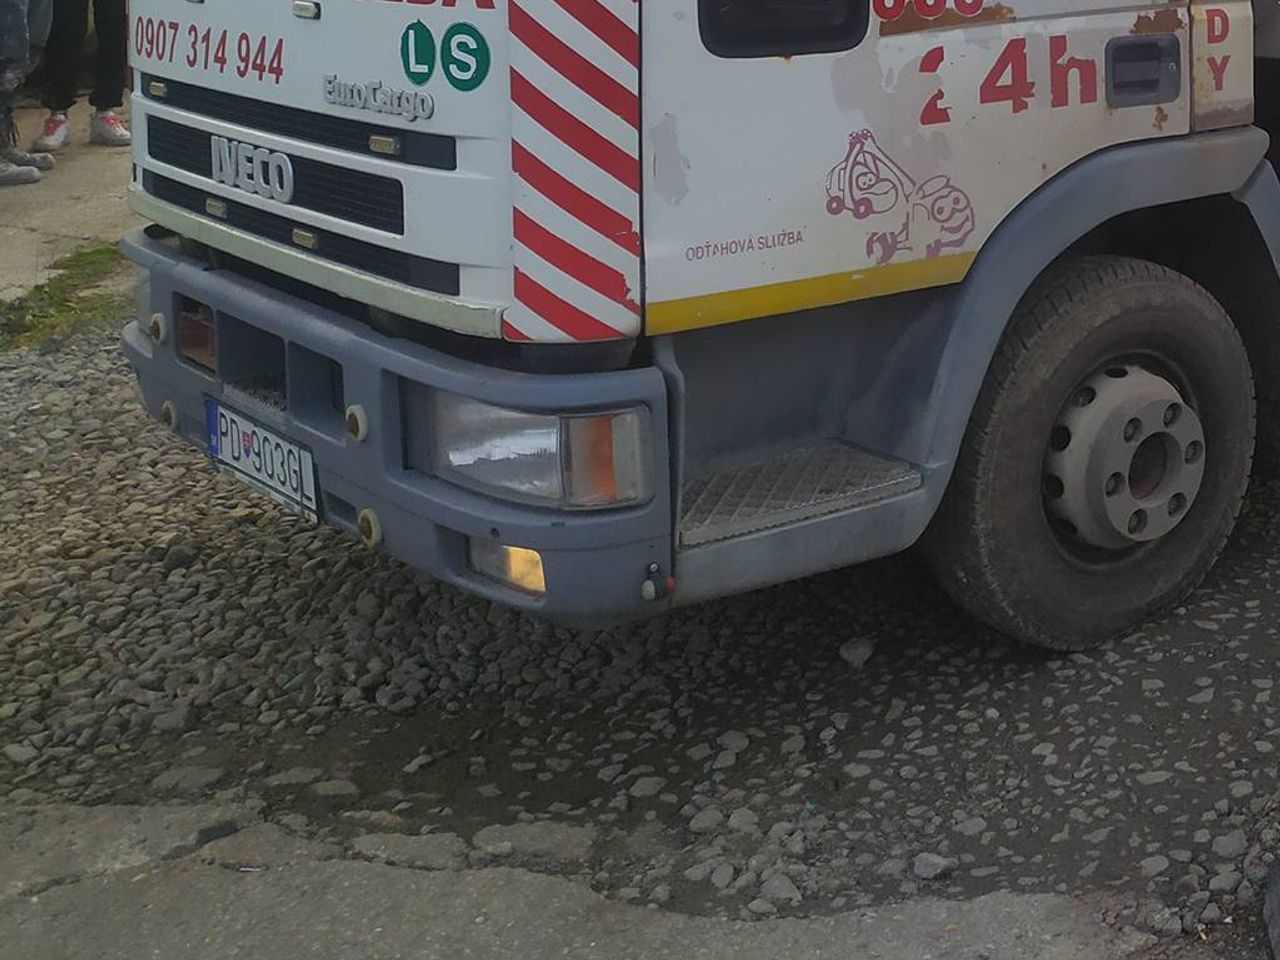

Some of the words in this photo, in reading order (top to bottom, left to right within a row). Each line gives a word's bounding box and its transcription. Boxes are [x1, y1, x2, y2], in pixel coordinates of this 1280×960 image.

[135, 16, 180, 63] 0907
[186, 24, 228, 74] 314
[236, 32, 285, 85] 944
[323, 74, 435, 123] EuroCargo
[210, 135, 294, 204] IVECO
[219, 411, 241, 461] PD
[251, 429, 313, 502] 903GL
